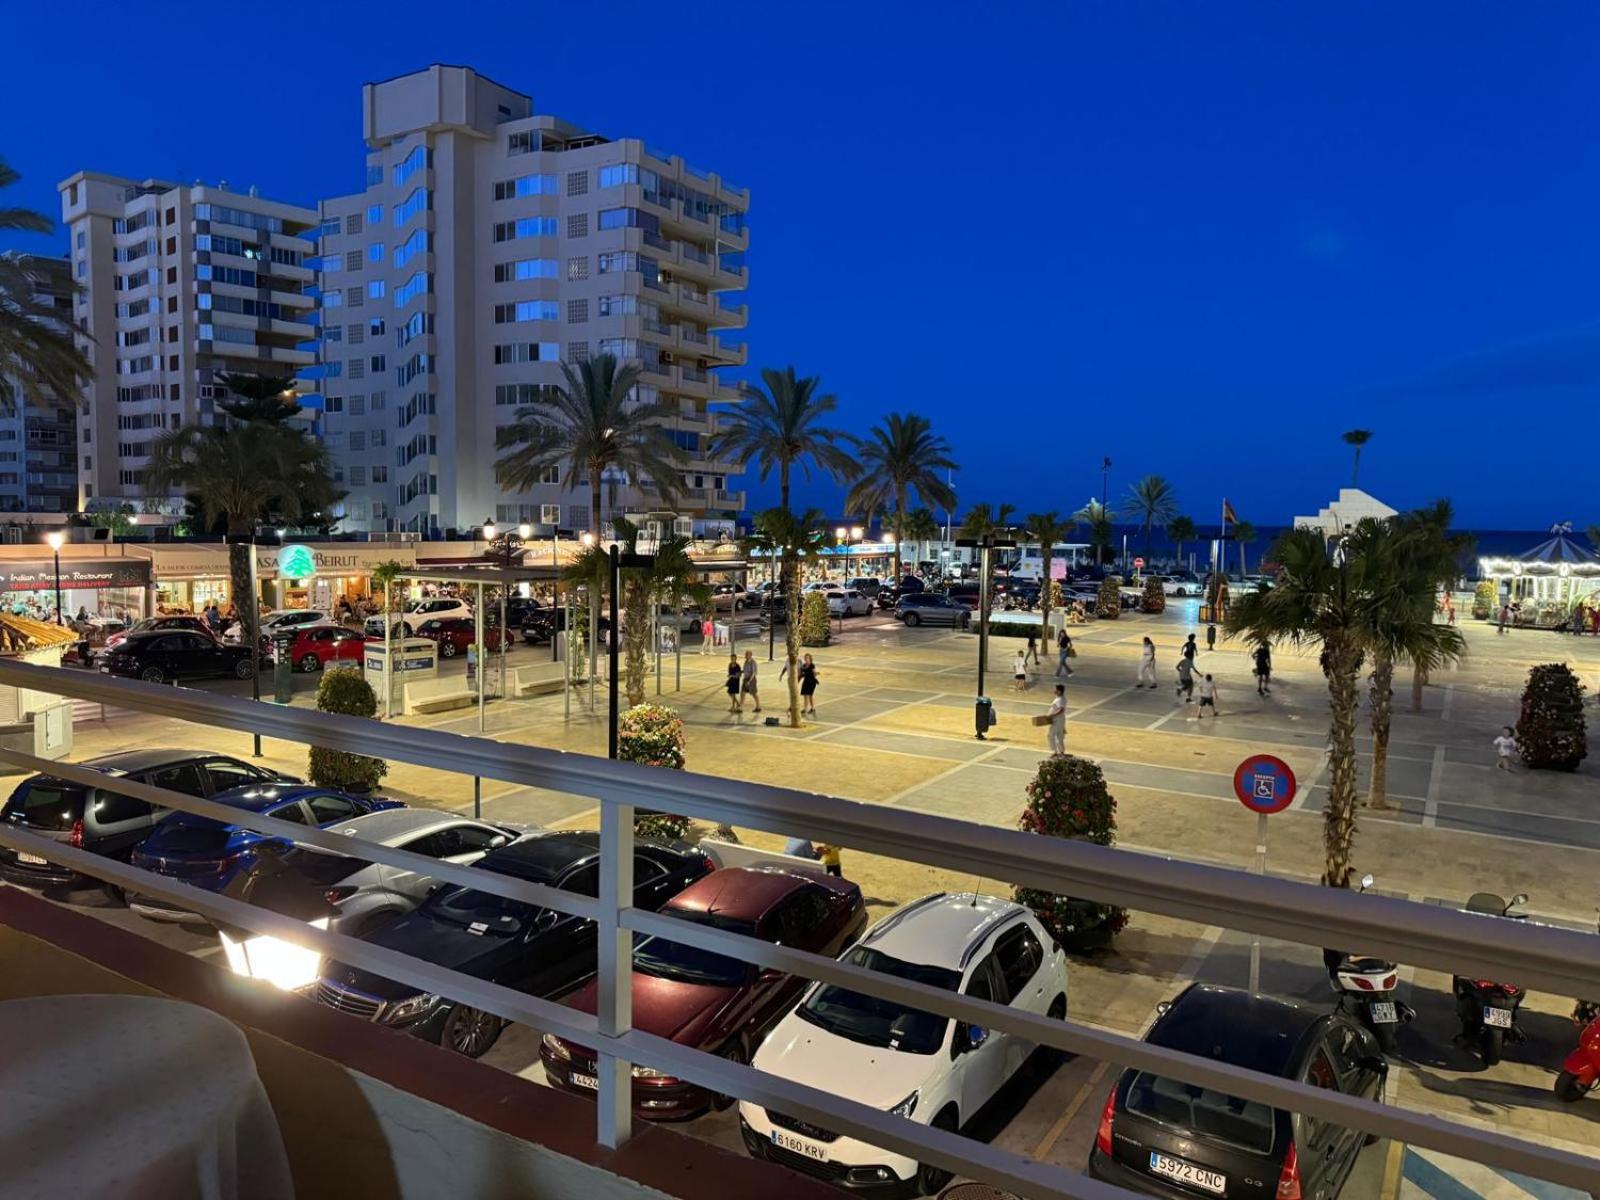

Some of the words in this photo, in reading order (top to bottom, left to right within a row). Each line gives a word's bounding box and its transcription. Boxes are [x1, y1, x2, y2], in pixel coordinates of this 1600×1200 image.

[256, 557, 280, 569] ASA
[312, 553, 359, 567] BEIRUT
[10, 573, 36, 582] Indian
[73, 572, 113, 580] Restaurant
[777, 1134, 802, 1152] 6160
[804, 1144, 825, 1159] KRV
[1159, 1157, 1192, 1178] 5972
[1195, 1169, 1222, 1188] CNC
